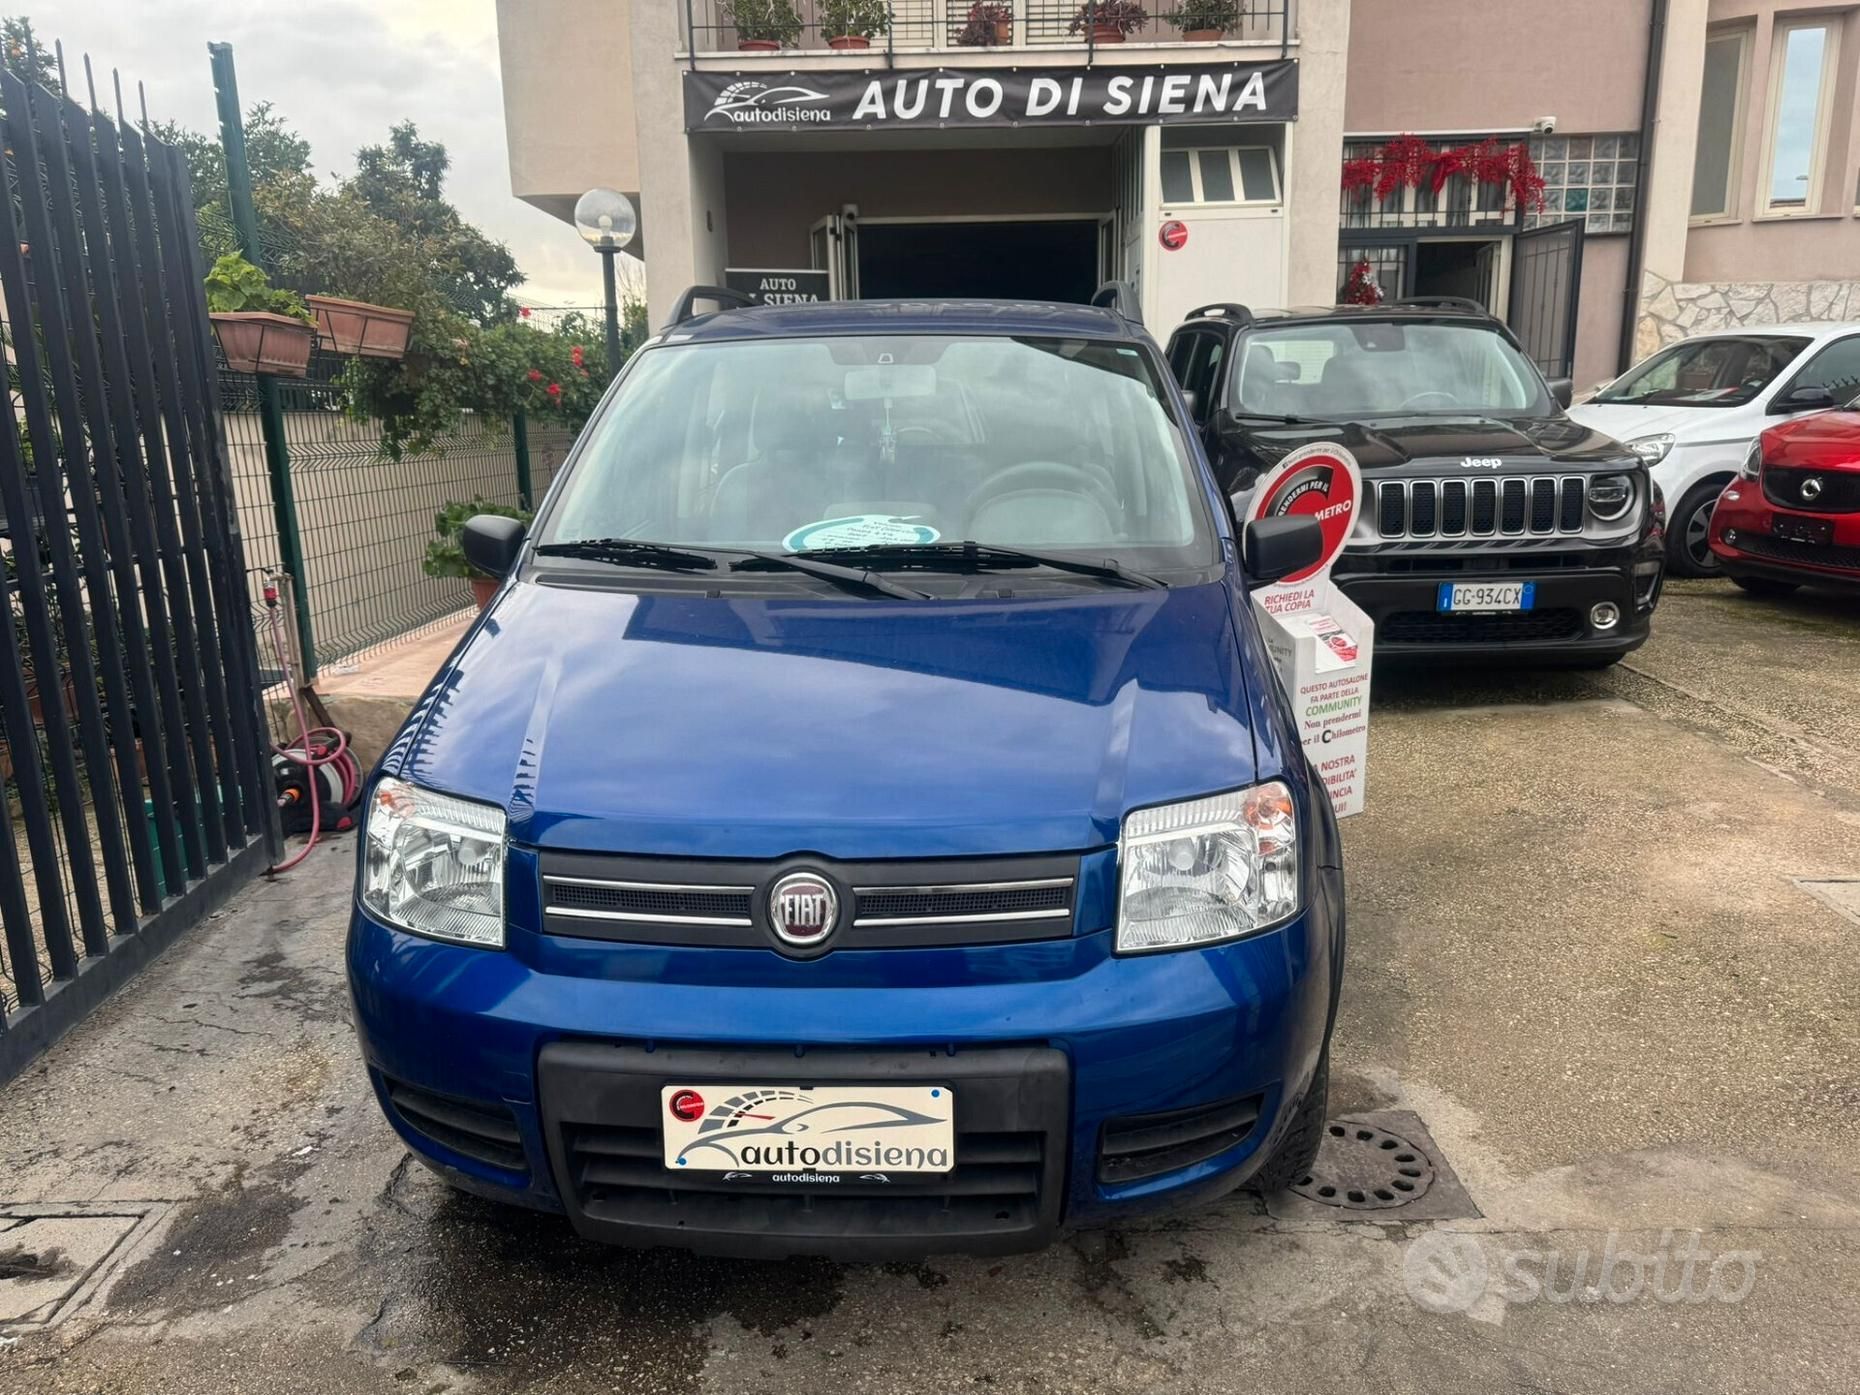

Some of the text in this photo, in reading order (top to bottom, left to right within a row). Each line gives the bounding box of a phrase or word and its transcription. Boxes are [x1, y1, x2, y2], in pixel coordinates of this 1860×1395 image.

[852, 71, 1268, 121] AUTO DI SIENA
[733, 106, 832, 123] autodisiena
[760, 278, 797, 291] AUTO
[1460, 457, 1503, 469] Jeep
[1309, 480, 1323, 491] PER
[1264, 588, 1315, 606] RICHIEDI LA
[1284, 600, 1311, 612] COPIA
[1300, 673, 1368, 695] QUESTO AUTOSALONE
[1310, 686, 1359, 704] FA PARTE DELLA
[1305, 696, 1362, 717] COMMUNITY
[1304, 709, 1362, 730] Non prendermi
[1313, 733, 1320, 744] il
[1321, 724, 1366, 744] Chilometro
[1320, 754, 1355, 771] NOSTRA
[784, 893, 824, 926] FIAT
[740, 1140, 948, 1169] autodisiena
[772, 1172, 840, 1184] autodisiena
